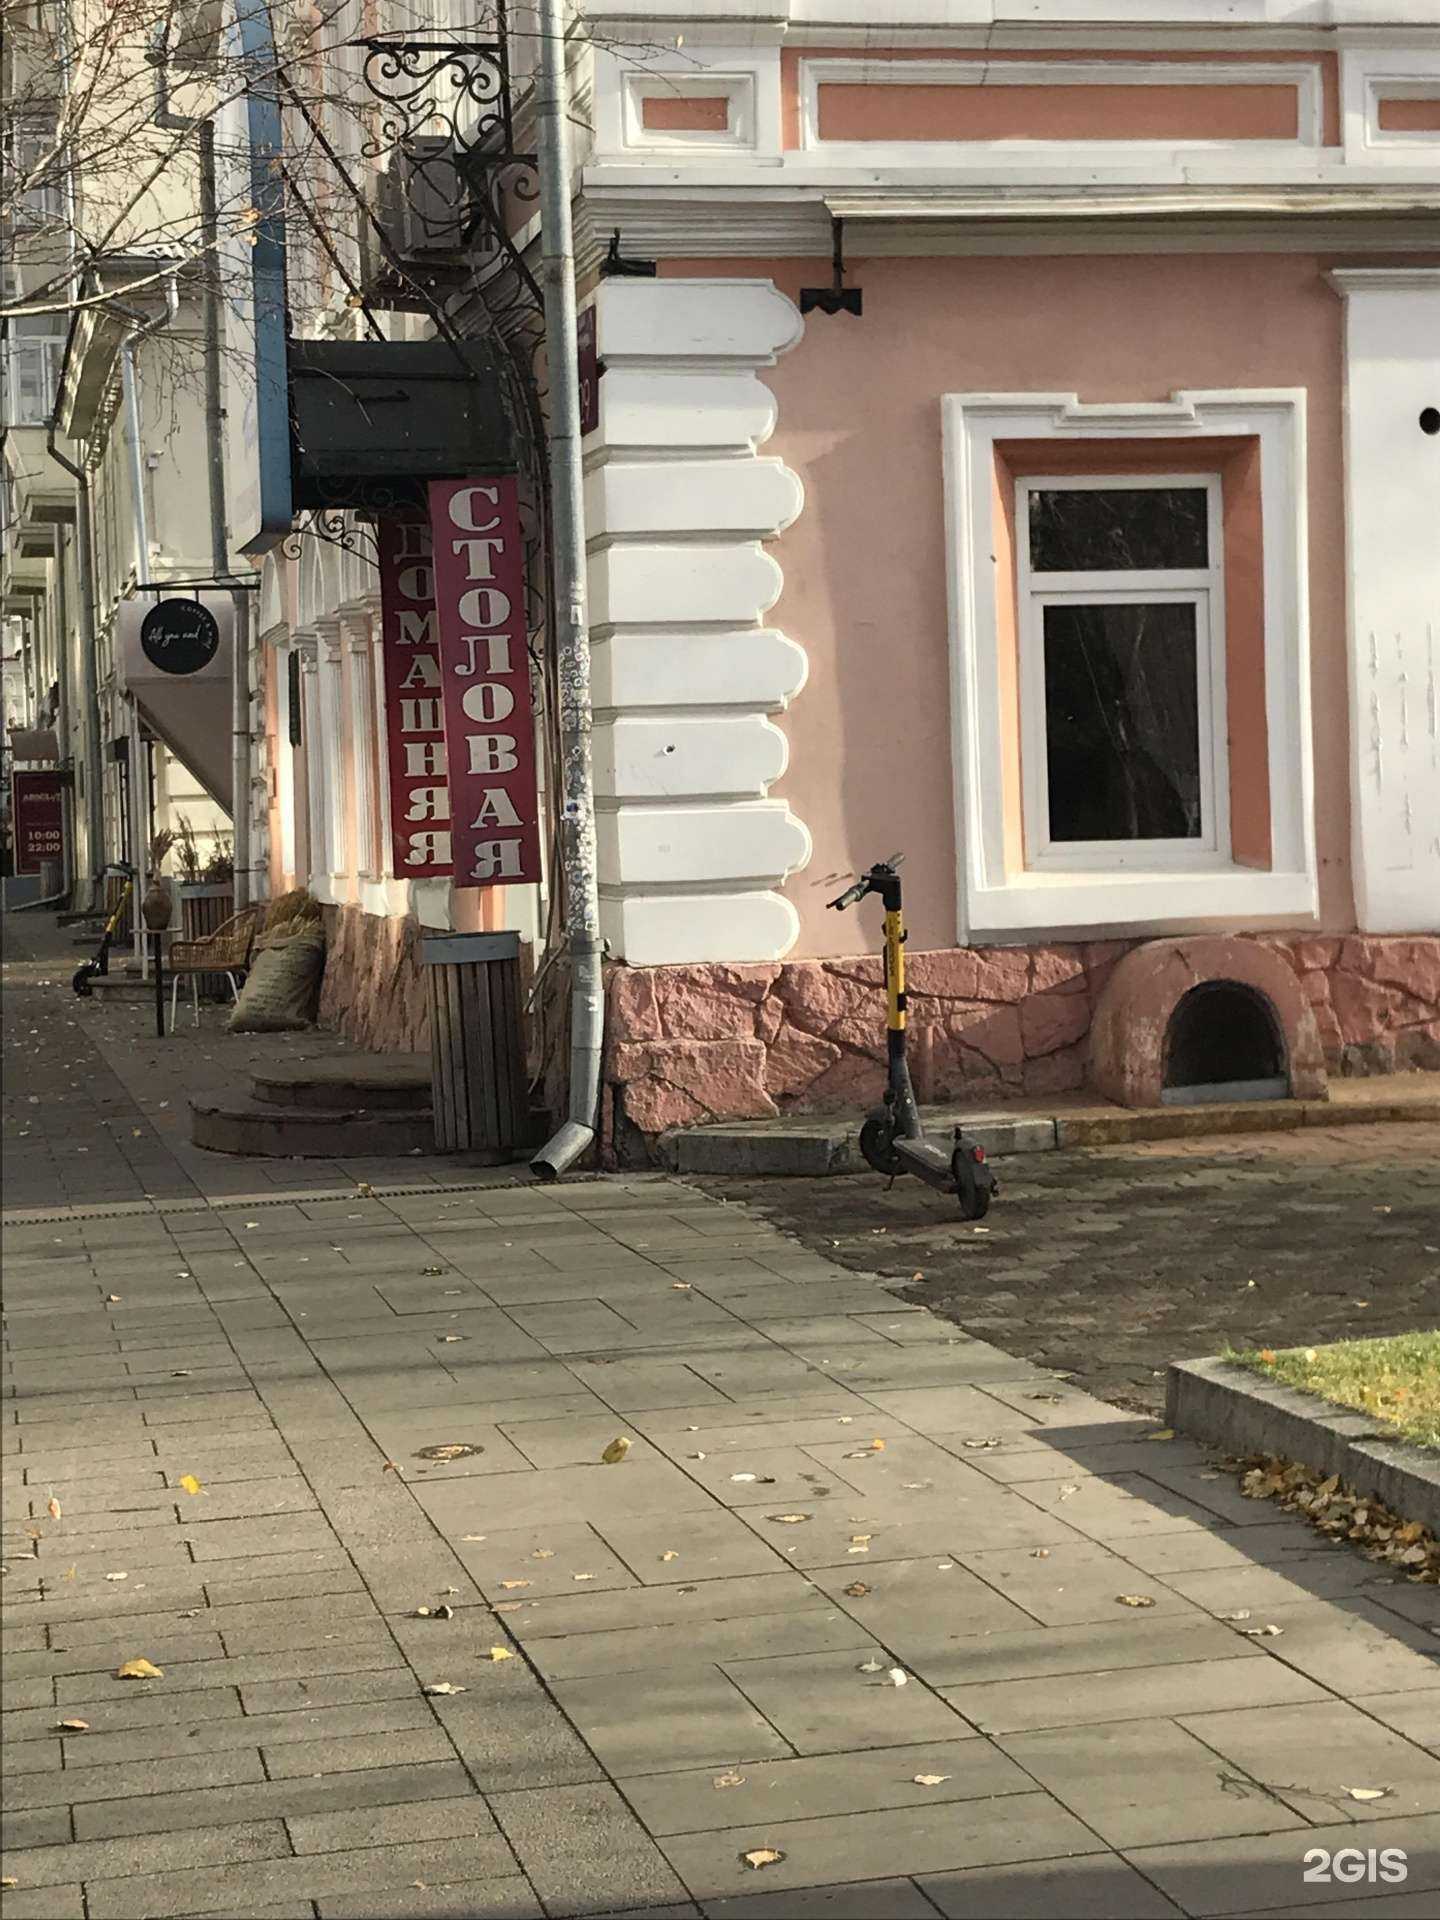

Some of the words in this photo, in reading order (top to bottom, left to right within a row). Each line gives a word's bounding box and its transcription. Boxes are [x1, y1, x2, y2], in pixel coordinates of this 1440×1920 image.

[393, 523, 454, 866] ДОМАШНЯЯ
[448, 487, 525, 878] СТОЛОВАЯ
[28, 831, 60, 841] 10:00
[28, 843, 60, 852] 22:00
